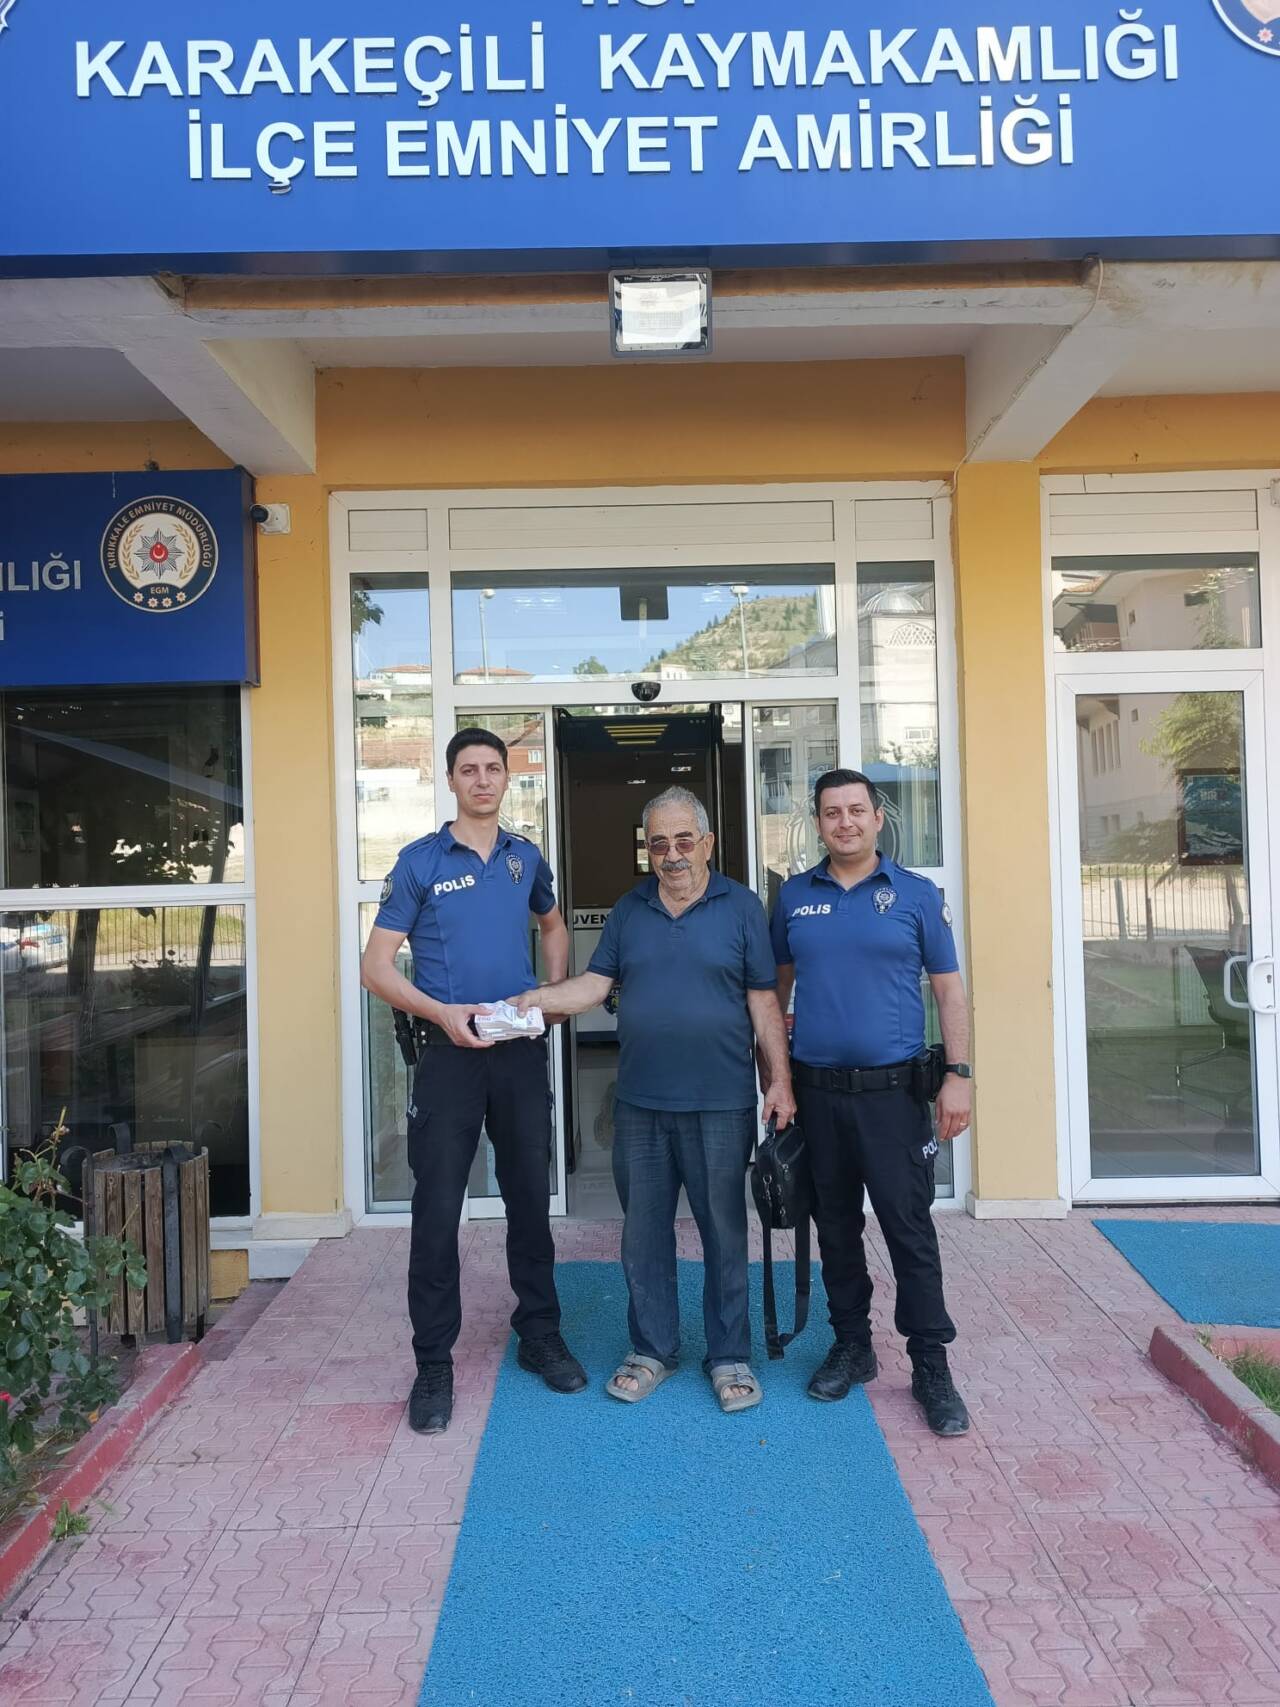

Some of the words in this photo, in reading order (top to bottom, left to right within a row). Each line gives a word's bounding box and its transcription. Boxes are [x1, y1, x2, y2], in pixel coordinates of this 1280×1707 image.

[76, 21, 546, 107] KARAKEÇİLİ
[599, 8, 1179, 90] KAYMAKAMLIĞI
[188, 108, 358, 193] İLÇE
[385, 103, 718, 177] EMNİYET
[737, 93, 1074, 171] AMİRLİĞİ
[106, 516, 130, 569] KIRIKKALE
[128, 502, 176, 519] EMNİYET
[175, 507, 212, 568] MÜDÜRLÜĞÜ
[0, 552, 81, 591] LIĞI
[150, 586, 169, 595] EGM
